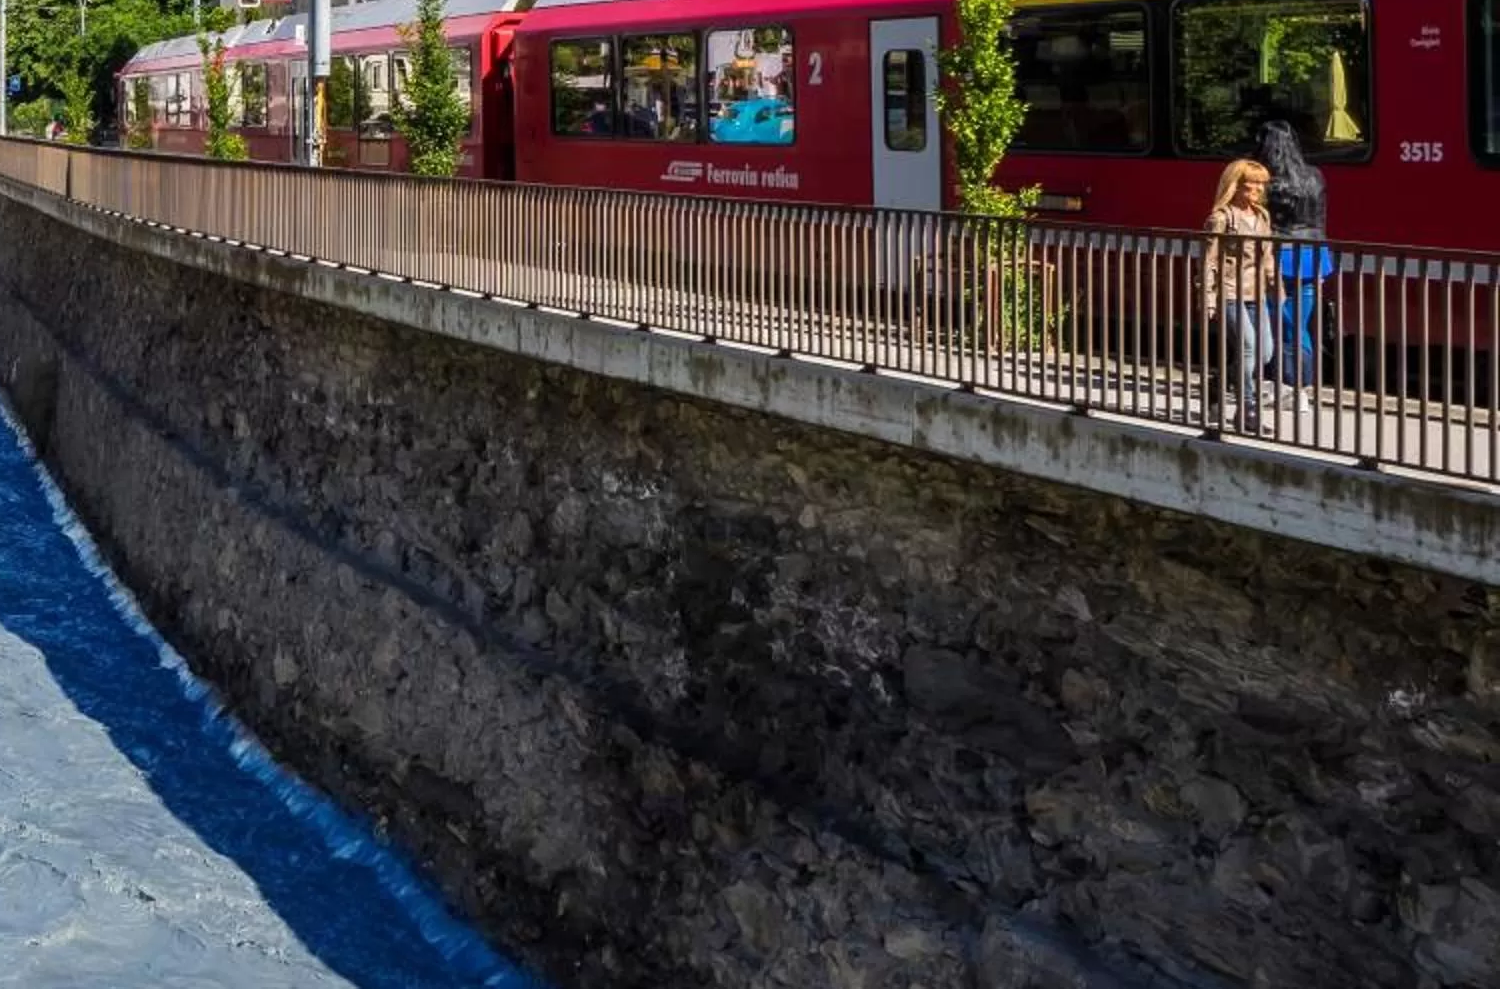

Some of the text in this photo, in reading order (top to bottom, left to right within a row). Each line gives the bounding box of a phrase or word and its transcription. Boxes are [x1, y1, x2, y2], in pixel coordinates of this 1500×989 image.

[809, 51, 822, 85] 2
[1399, 141, 1443, 162] 3515
[706, 162, 758, 186] Ferrovia
